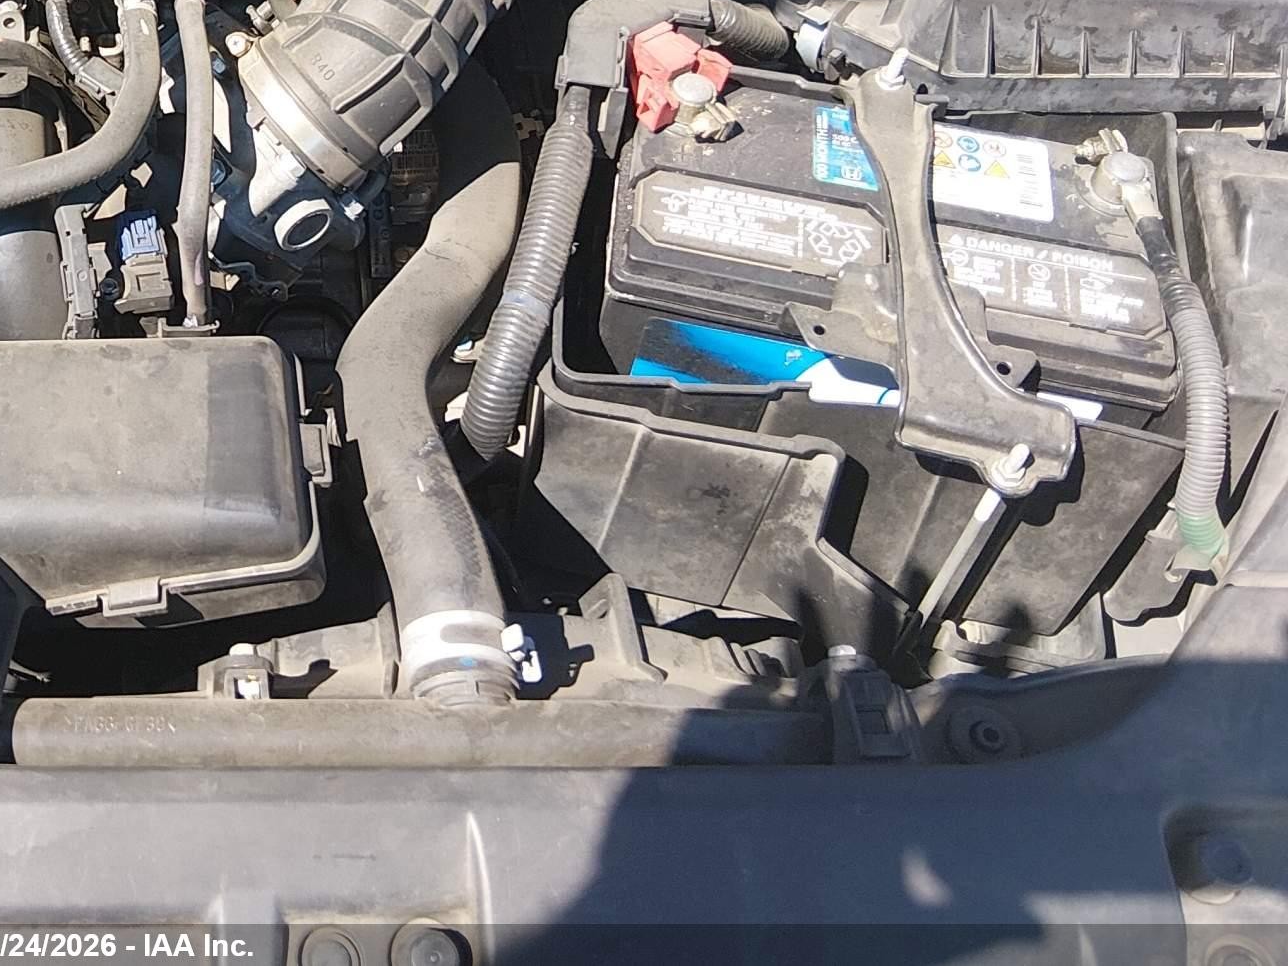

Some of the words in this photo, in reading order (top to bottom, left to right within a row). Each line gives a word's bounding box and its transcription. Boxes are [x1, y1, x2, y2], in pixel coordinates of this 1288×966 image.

[815, 129, 829, 162] MONTH
[965, 236, 1035, 258] DANGER
[1051, 250, 1113, 271] POISON
